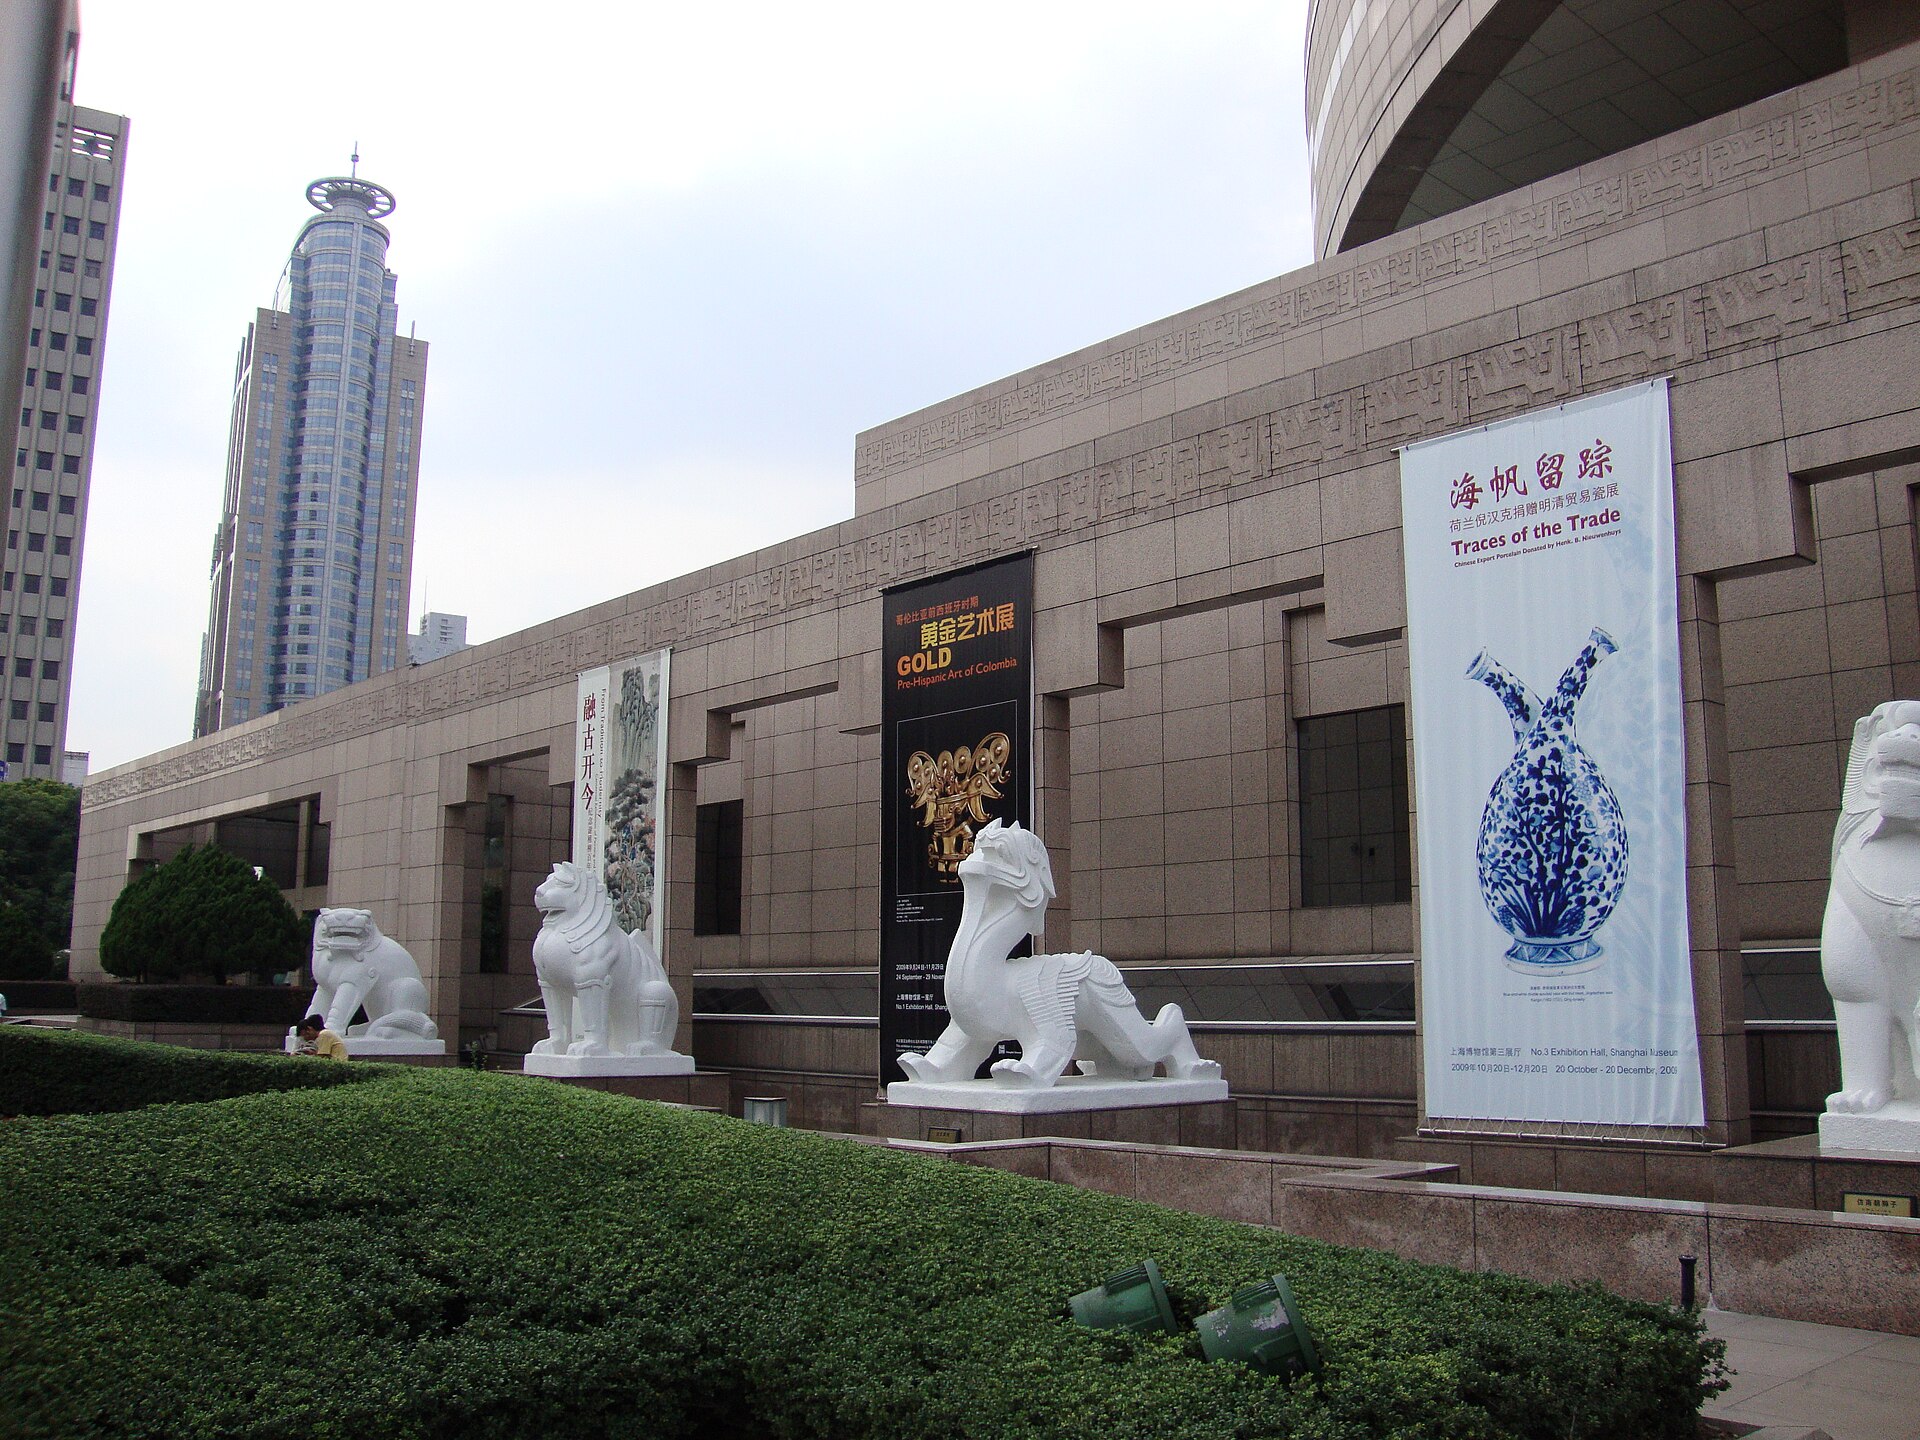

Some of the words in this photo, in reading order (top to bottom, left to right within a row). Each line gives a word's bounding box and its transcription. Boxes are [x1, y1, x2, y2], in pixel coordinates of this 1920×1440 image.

[1450, 438, 1613, 510] 海帆留踪
[1449, 482, 1619, 532] 荷兰倪汉克捐赠明清贸易瓷展
[1451, 534, 1506, 556] Traces
[1511, 526, 1528, 544] of
[1533, 522, 1562, 539] the
[1567, 508, 1621, 531] Trade
[1454, 560, 1476, 568] Chinese
[1477, 555, 1495, 564] Export
[1496, 549, 1521, 560] Porcelain
[1522, 544, 1547, 554] Donated
[896, 595, 979, 626] 哥伦比亚前西班牙时期
[921, 602, 1014, 650] 黄金艺术展
[897, 647, 952, 676] GOLD
[898, 673, 946, 690] Pre-Hispanic
[948, 669, 962, 680] Art
[964, 665, 973, 677] of
[976, 656, 1017, 674] Colombia
[581, 692, 596, 811] 融古开今
[1451, 1047, 1521, 1057] 上海博物馆第三展厅
[1530, 1048, 1548, 1056] No.3
[1551, 1048, 1588, 1056] Exhibition
[1590, 1048, 1608, 1057] Hall,
[1610, 1048, 1648, 1058] Shanghai
[1452, 1063, 1547, 1073] 2009年10月20日-12月20日
[1556, 1065, 1565, 1073] 20
[1567, 1065, 1598, 1074] October
[1606, 1066, 1615, 1074] 20
